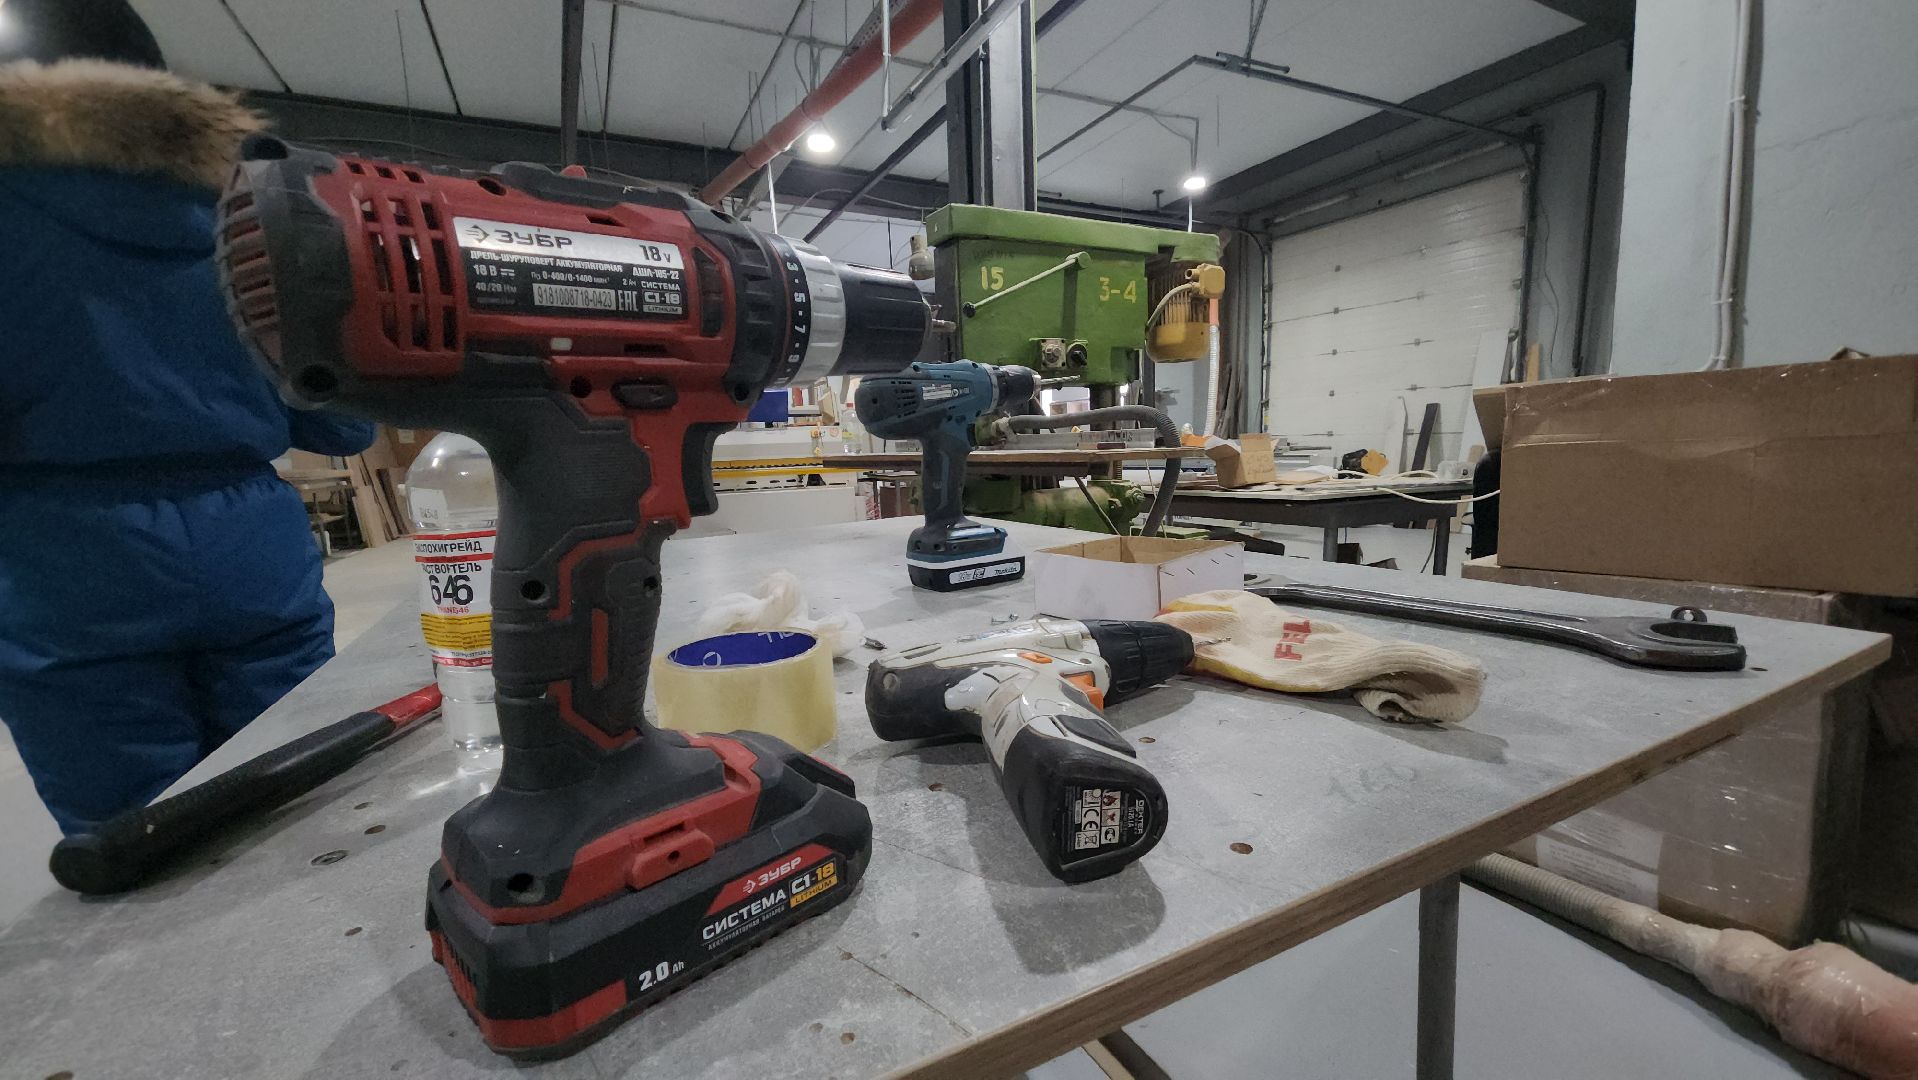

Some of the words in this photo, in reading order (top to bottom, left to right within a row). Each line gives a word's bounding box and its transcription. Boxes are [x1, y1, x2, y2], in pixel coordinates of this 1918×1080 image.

[494, 229, 572, 249] ЗУБР
[470, 250, 554, 266] ДРЕЛЬ-ШУРУПОВЕРТ
[556, 258, 623, 273] АККУМУЛЯТОРНАЯ
[639, 244, 662, 262] 18
[786, 261, 799, 272] 3
[980, 265, 1005, 291] 15
[536, 285, 614, 309] 9181008718-0423
[640, 280, 681, 291] СИСТЕМА
[794, 292, 806, 303] 5
[1098, 276, 1137, 304] 3-4
[794, 324, 806, 334] 7
[429, 574, 474, 605] 646
[1083, 809, 1099, 830] CE
[757, 856, 802, 887] ЗУБР
[793, 878, 835, 904] LITHIUM
[701, 888, 787, 940] СИСТЕМА
[708, 918, 760, 951] АККУМУЛЯТОРНАЯ
[638, 961, 670, 991] 2.0
[671, 961, 685, 975] Ah
